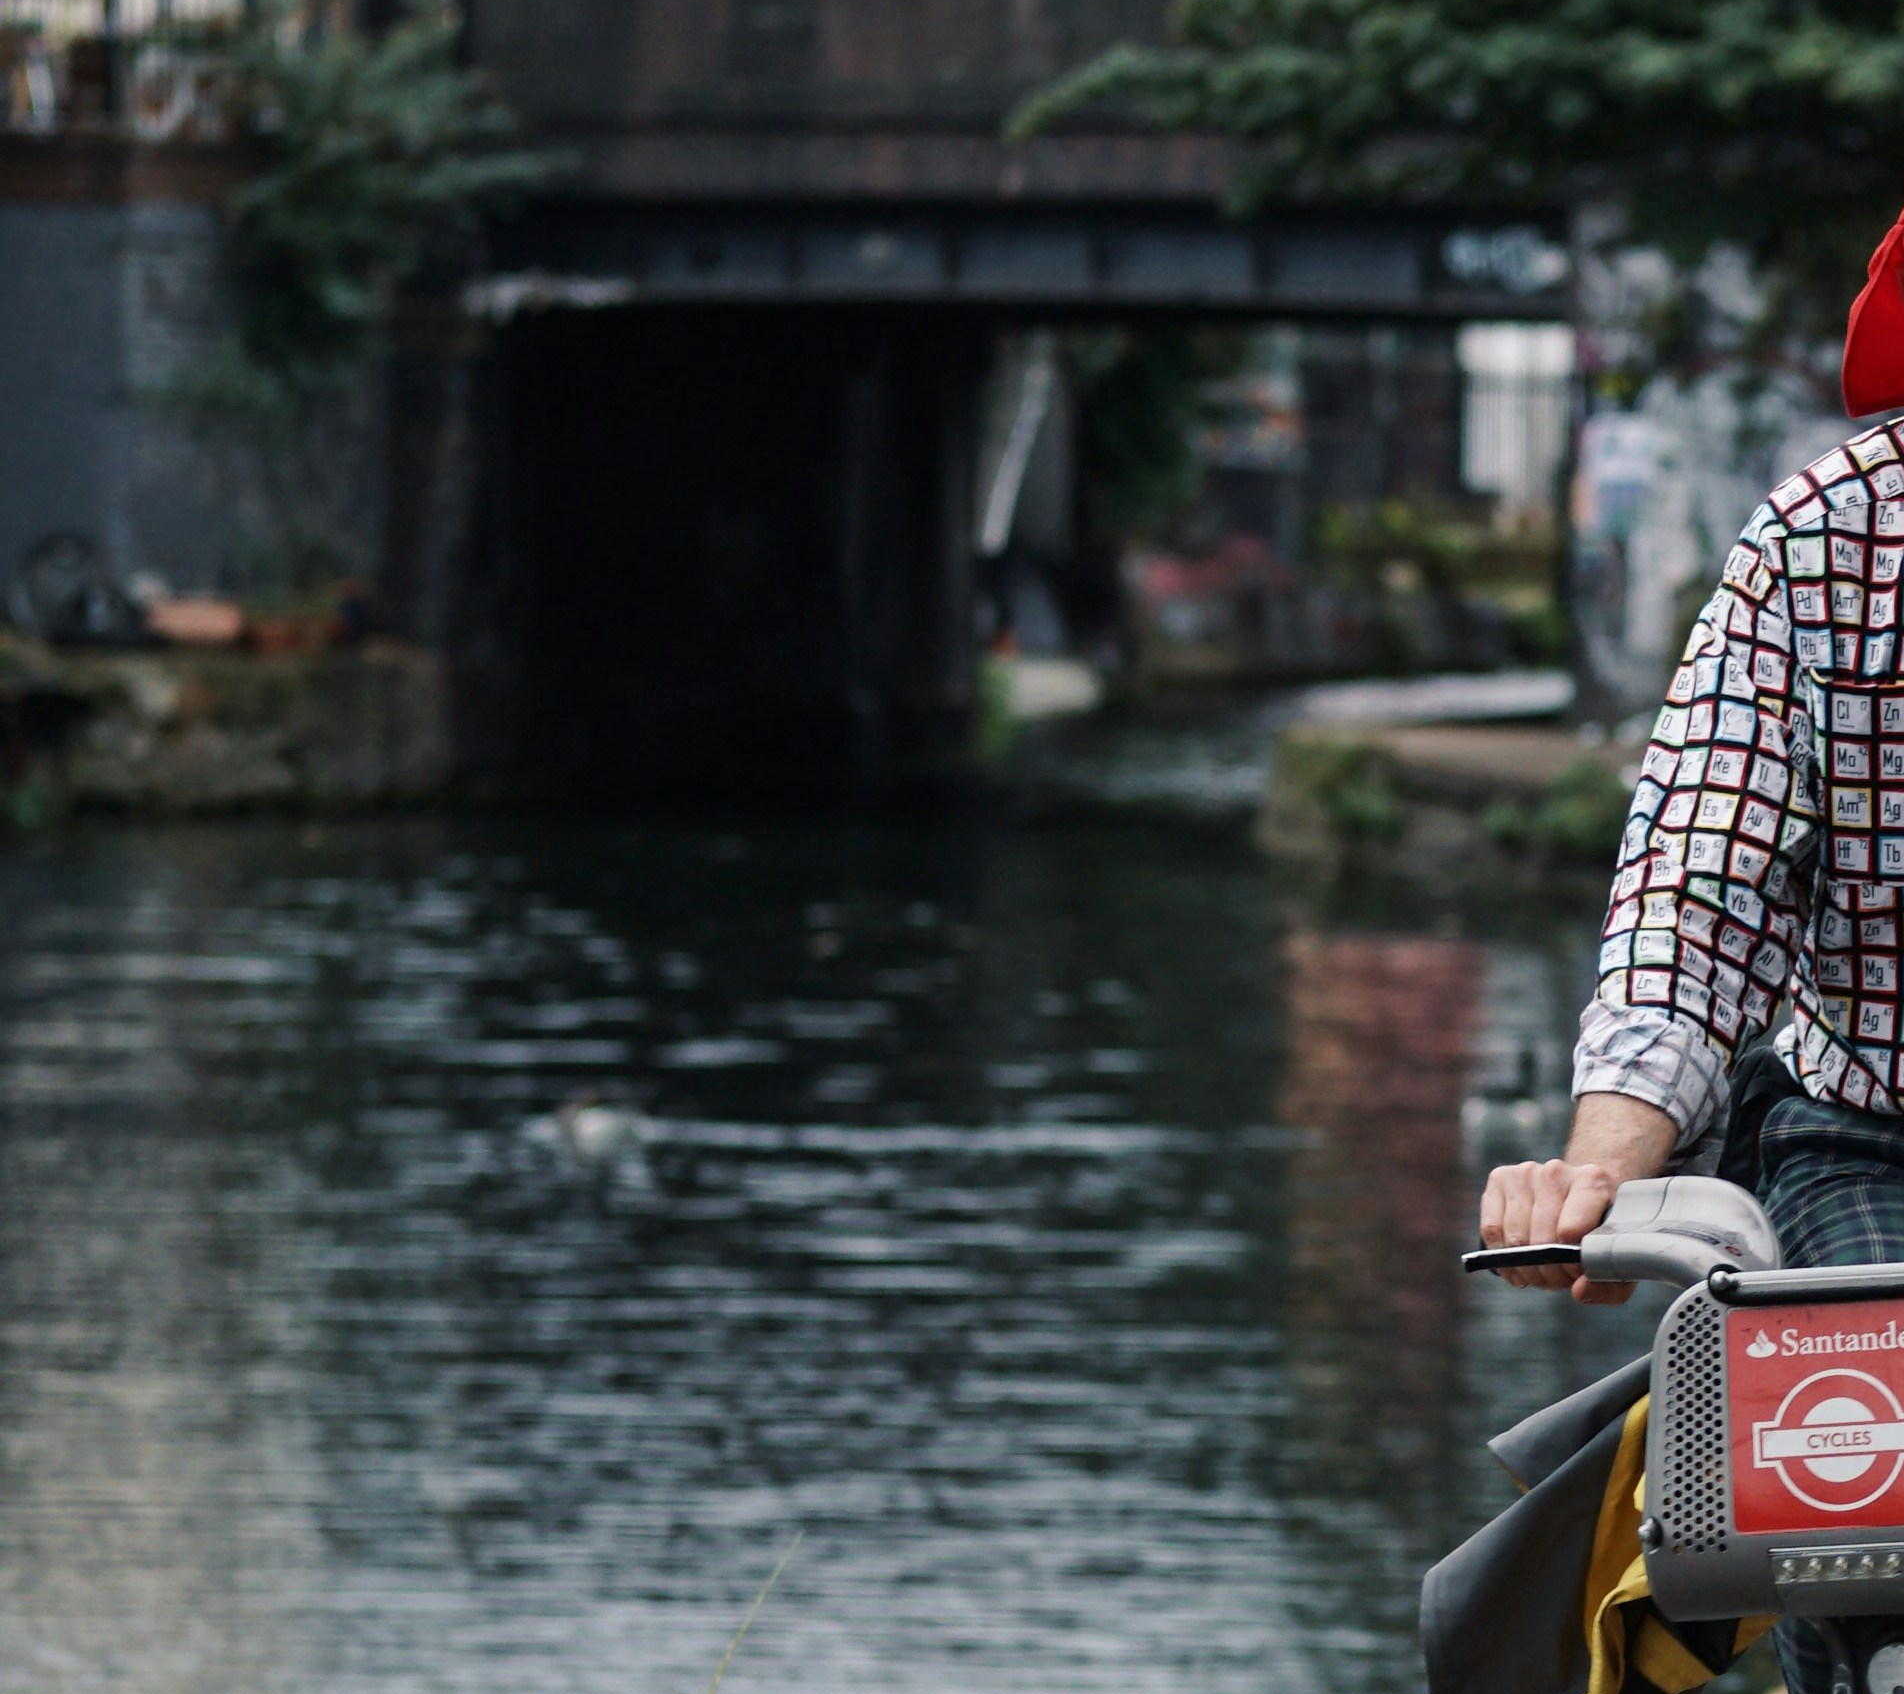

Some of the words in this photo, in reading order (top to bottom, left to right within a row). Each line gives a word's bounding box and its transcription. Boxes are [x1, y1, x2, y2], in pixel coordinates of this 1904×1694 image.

[1801, 637, 1817, 656] Rb
[1730, 664, 1742, 682] Br
[1758, 656, 1772, 676] Nb
[1884, 703, 1900, 722] Zn
[1662, 714, 1673, 730] O
[1713, 754, 1730, 774] Re
[1837, 748, 1856, 767] Mo
[1883, 748, 1902, 772] Mg
[1704, 800, 1717, 816] Es
[1837, 796, 1859, 814] Am
[1884, 797, 1900, 820] Ag
[1745, 806, 1763, 826] Au
[1694, 841, 1706, 858] Bi
[1738, 848, 1750, 866] Te
[1838, 841, 1851, 858] Hf
[1884, 844, 1900, 862] Tb
[1654, 862, 1670, 876] Bh
[1650, 901, 1664, 917] Ac
[1732, 894, 1747, 912] Yb
[1722, 928, 1738, 945] Cr
[1864, 923, 1880, 936] Zn
[1640, 936, 1649, 952] C
[1758, 950, 1774, 966] Al
[1864, 960, 1883, 984] Mg
[1636, 974, 1650, 990] Zr
[1716, 1006, 1730, 1025] Nb
[1862, 1008, 1878, 1031] Ag
[1806, 1430, 1873, 1449] CYCLES
